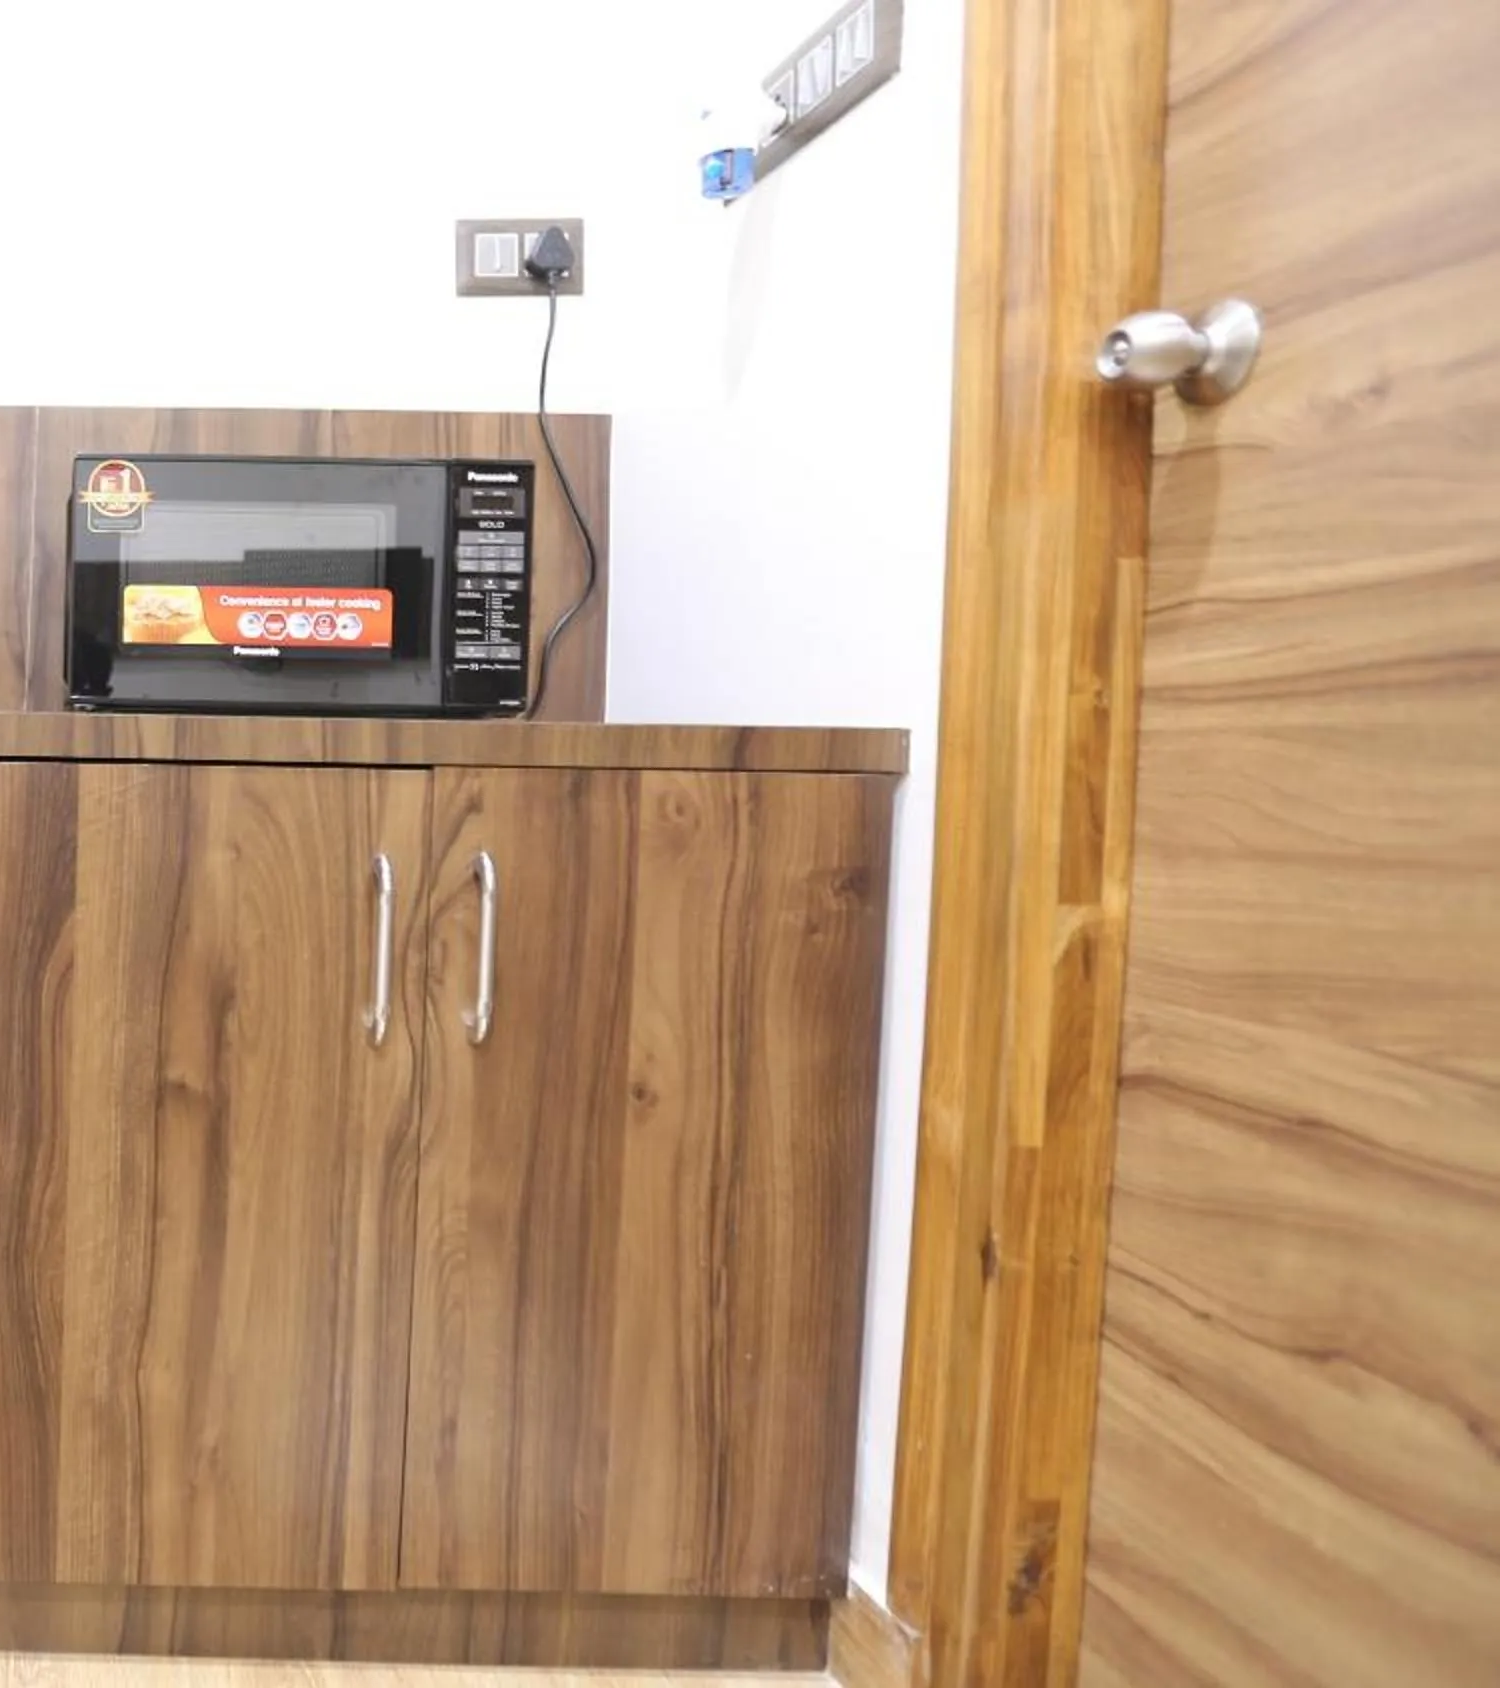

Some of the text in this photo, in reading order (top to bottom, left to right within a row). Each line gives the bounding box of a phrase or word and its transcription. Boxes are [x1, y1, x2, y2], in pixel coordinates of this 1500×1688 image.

[467, 471, 519, 482] Panasonic
[220, 595, 289, 607] Convenience
[338, 597, 381, 611] cooking
[233, 646, 280, 657] Panasonic
